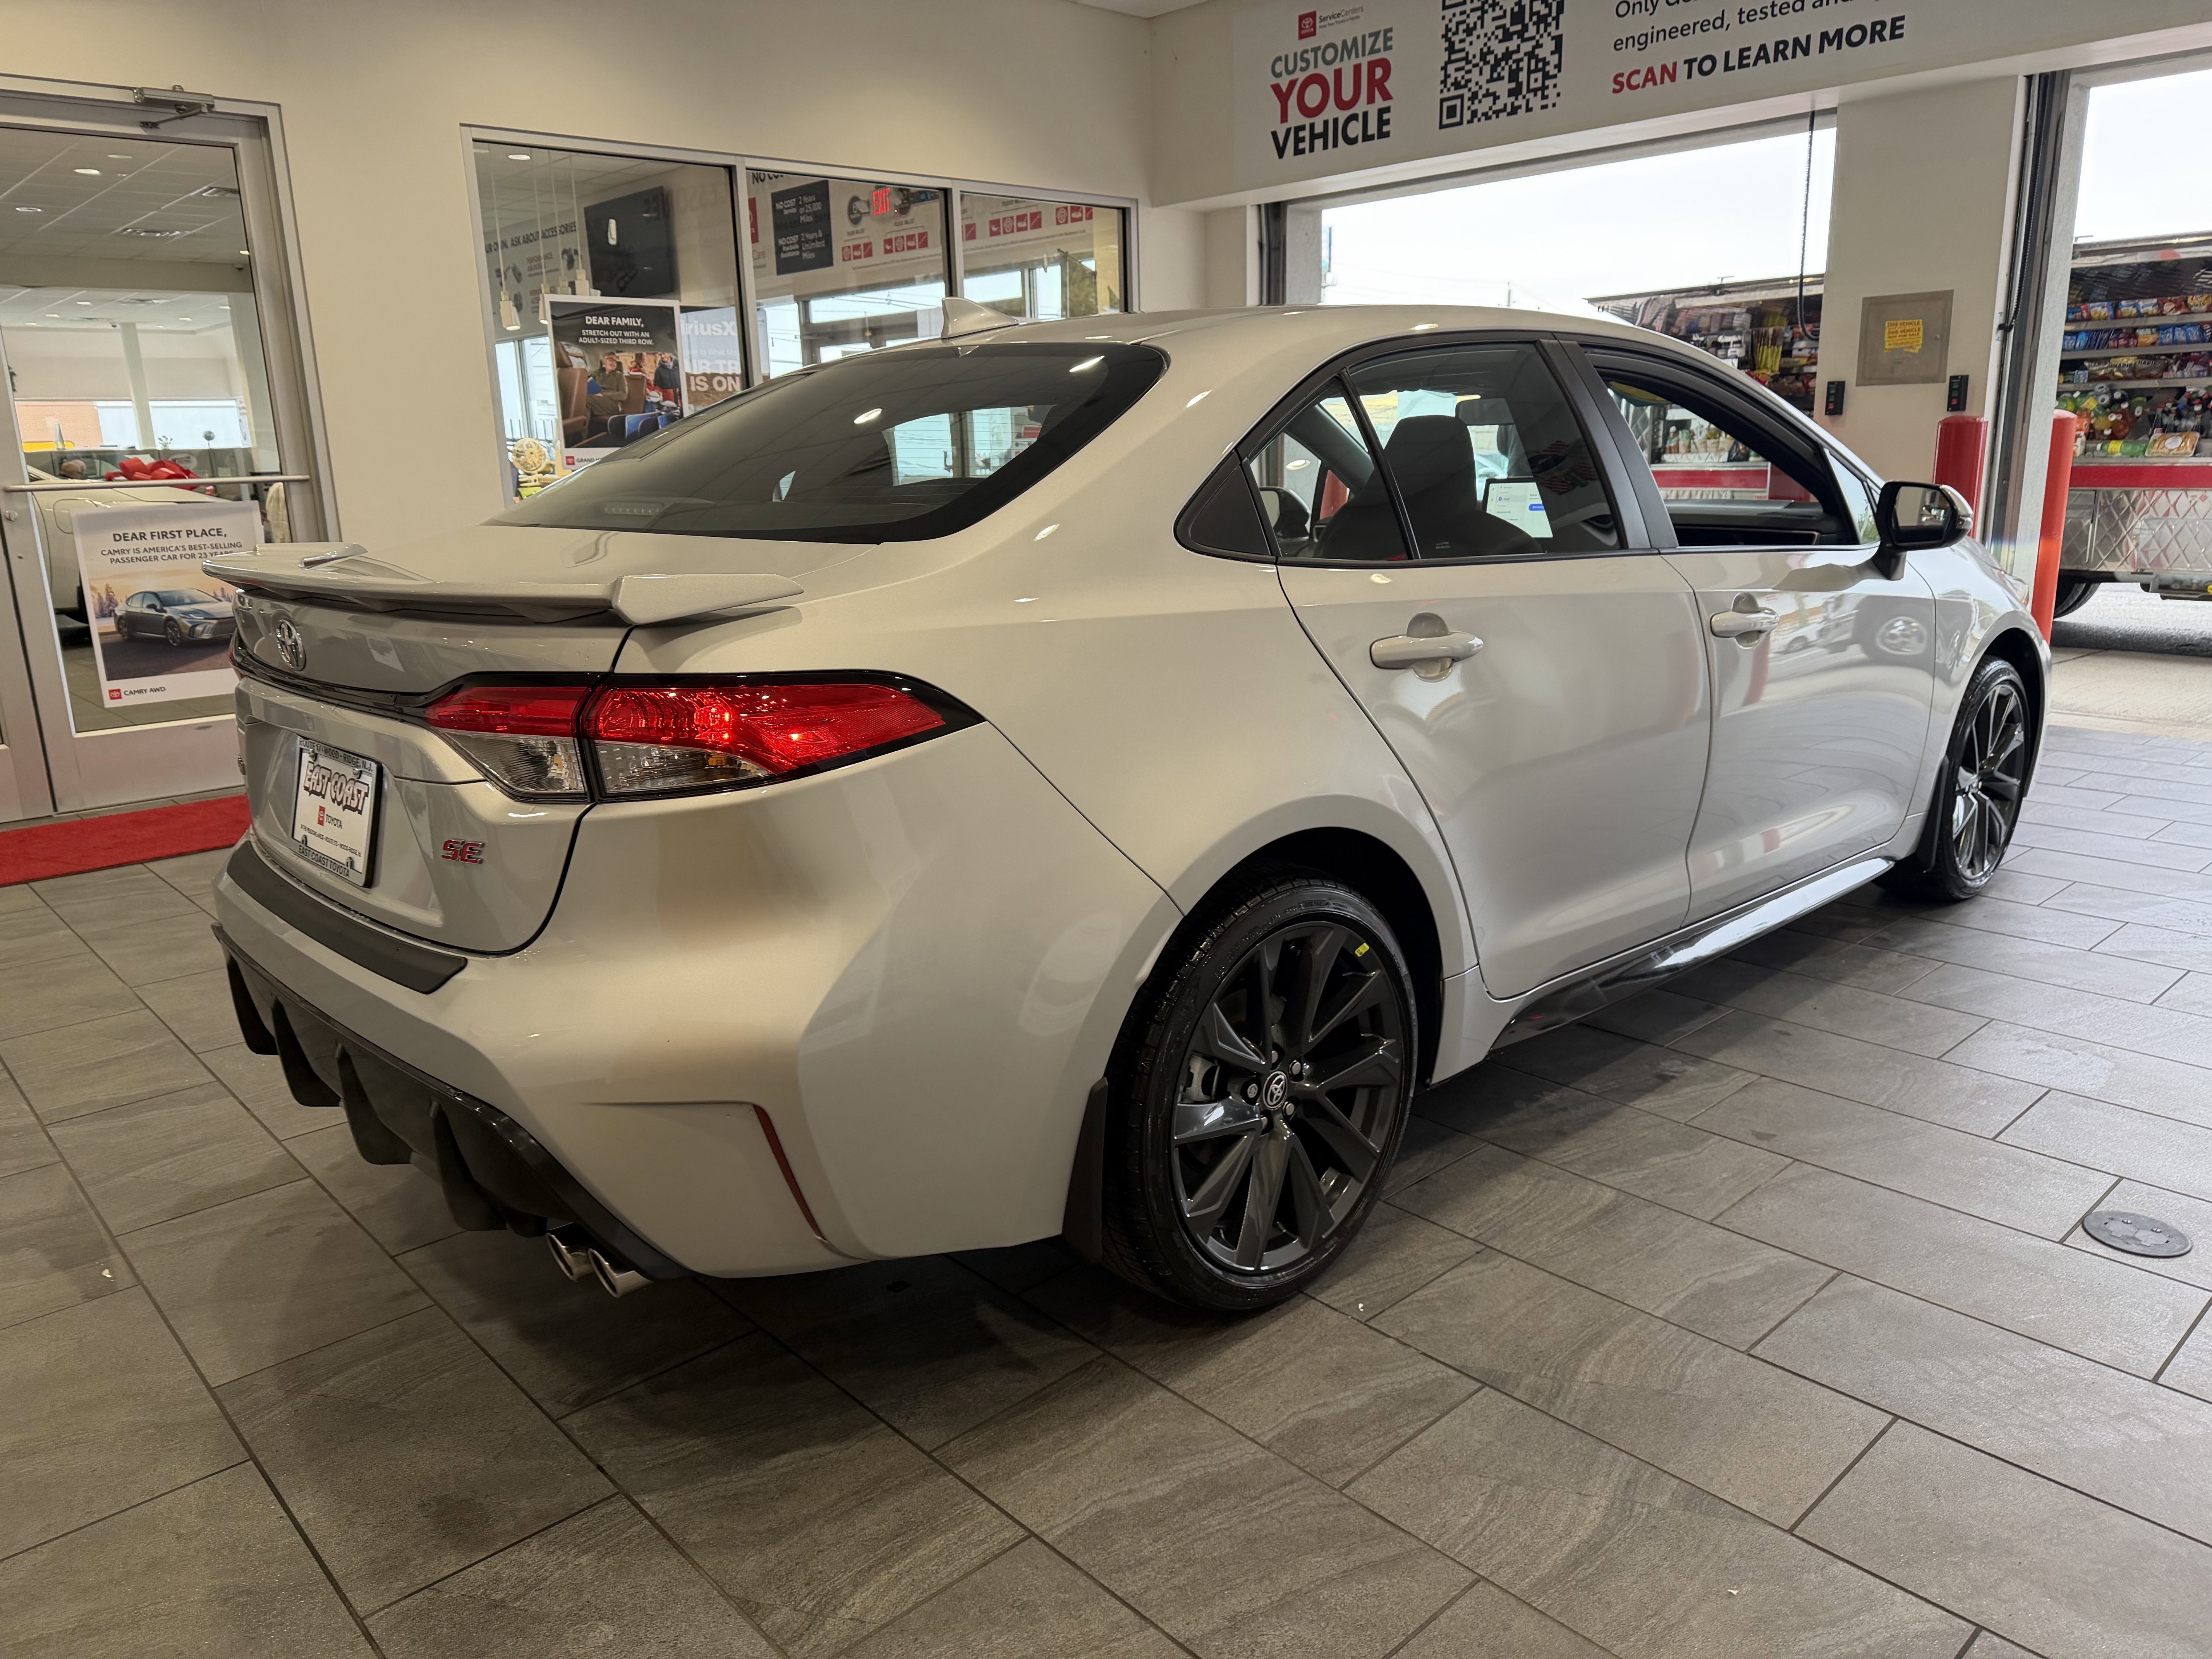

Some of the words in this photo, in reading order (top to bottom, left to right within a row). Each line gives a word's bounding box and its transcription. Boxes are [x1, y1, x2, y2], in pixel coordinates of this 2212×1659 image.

[1615, 0, 1660, 18] Only
[1613, 9, 1731, 52] engineered,
[1737, 0, 1805, 25] tested
[1271, 27, 1393, 78] CUSTOMIZE
[1612, 61, 1677, 94] SCAN
[1683, 54, 1717, 80] TO
[1723, 33, 1812, 72] LEARN
[1818, 14, 1906, 54] MORE
[1270, 57, 1394, 124] YOUR
[1271, 105, 1391, 159] VEHICLE
[872, 187, 890, 215] EXIT
[585, 316, 610, 325] DEAR
[611, 317, 644, 327] FAMILY,
[690, 376, 708, 392] IS
[712, 376, 741, 392] ON
[113, 531, 148, 543] DEAR
[150, 530, 183, 540] FIRST
[186, 528, 227, 538] PLACE,
[101, 548, 131, 556] CAMRY
[143, 545, 186, 554] AMERICA'S
[188, 542, 242, 551] BEST-SELLING
[110, 554, 160, 564] PASSENGER
[161, 553, 178, 561] CAR
[299, 737, 316, 750] ROUTE
[304, 761, 332, 799] EAST
[330, 772, 369, 816] COAST
[326, 814, 342, 830] TOYOTA
[298, 844, 311, 858] EAST
[311, 852, 329, 867] COAST
[329, 860, 350, 878] TOYOTA
[441, 839, 485, 865] SE
